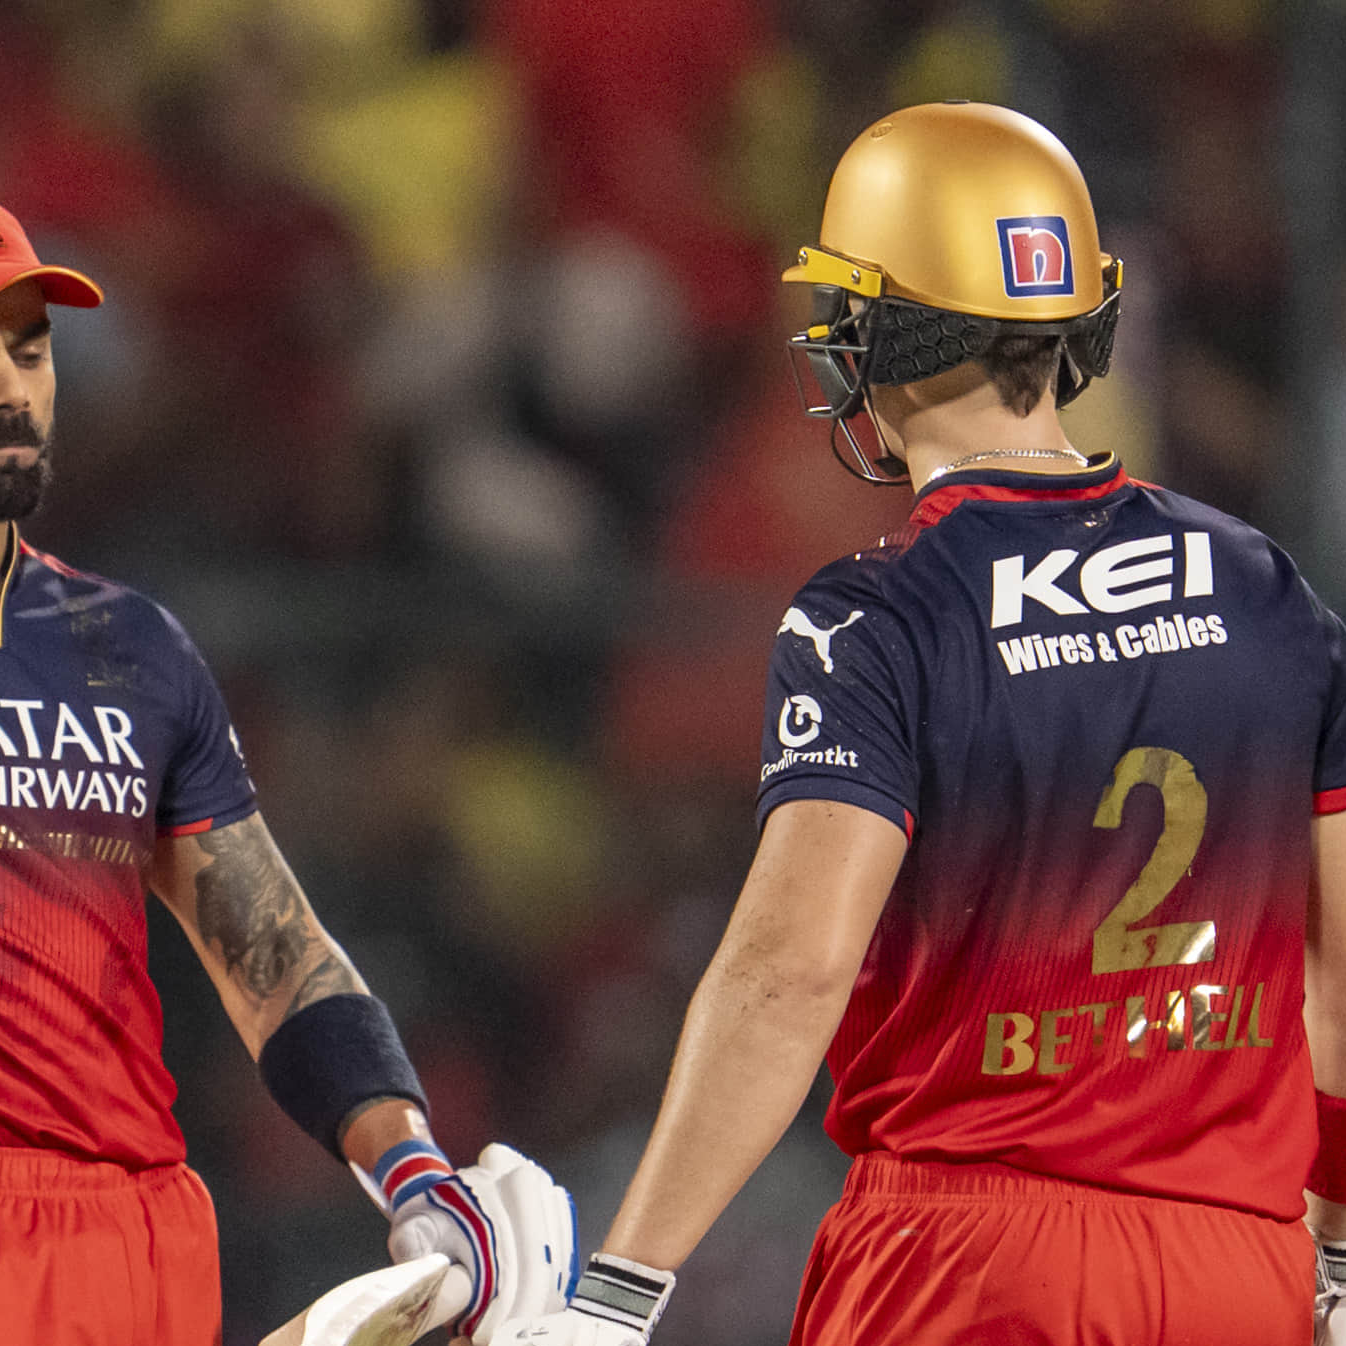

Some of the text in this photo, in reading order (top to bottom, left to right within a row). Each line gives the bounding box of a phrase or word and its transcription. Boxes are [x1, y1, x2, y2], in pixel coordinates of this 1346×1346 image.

[990, 531, 1214, 629] KEI
[997, 613, 1229, 676] Wires & Cables
[1091, 746, 1216, 976] 2
[980, 982, 1274, 1076] BETHELL
